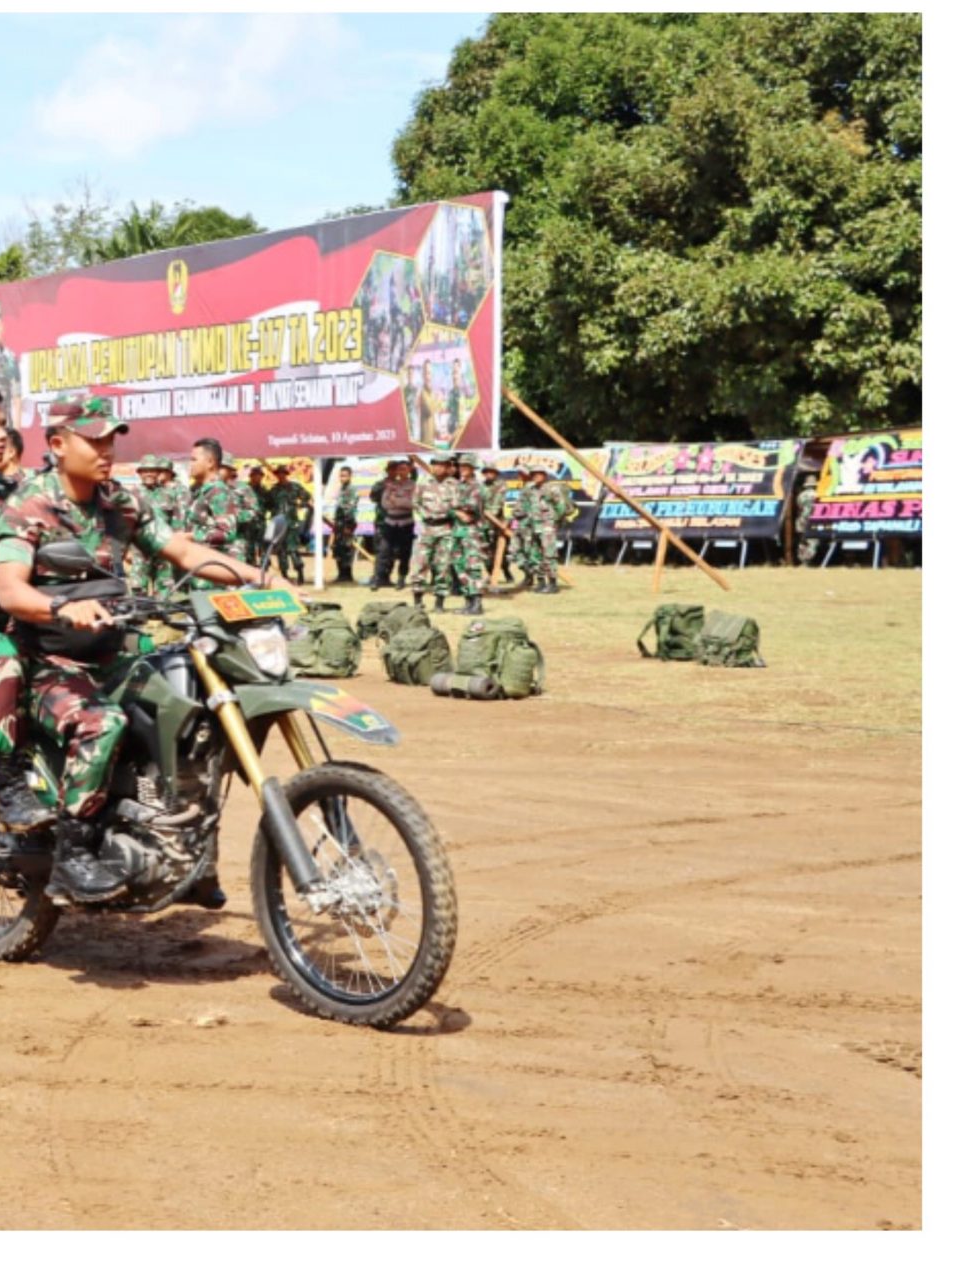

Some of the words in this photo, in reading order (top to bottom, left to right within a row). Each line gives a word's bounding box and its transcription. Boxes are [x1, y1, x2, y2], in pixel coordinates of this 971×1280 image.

[29, 341, 87, 394] UPACARA
[90, 330, 177, 387] PENUTUPAN
[180, 323, 228, 378] TMMD
[230, 314, 286, 373] KE-117
[289, 313, 311, 368] TA
[313, 306, 363, 365] 2023
[332, 431, 342, 443] 10
[810, 500, 898, 519] DINAS
